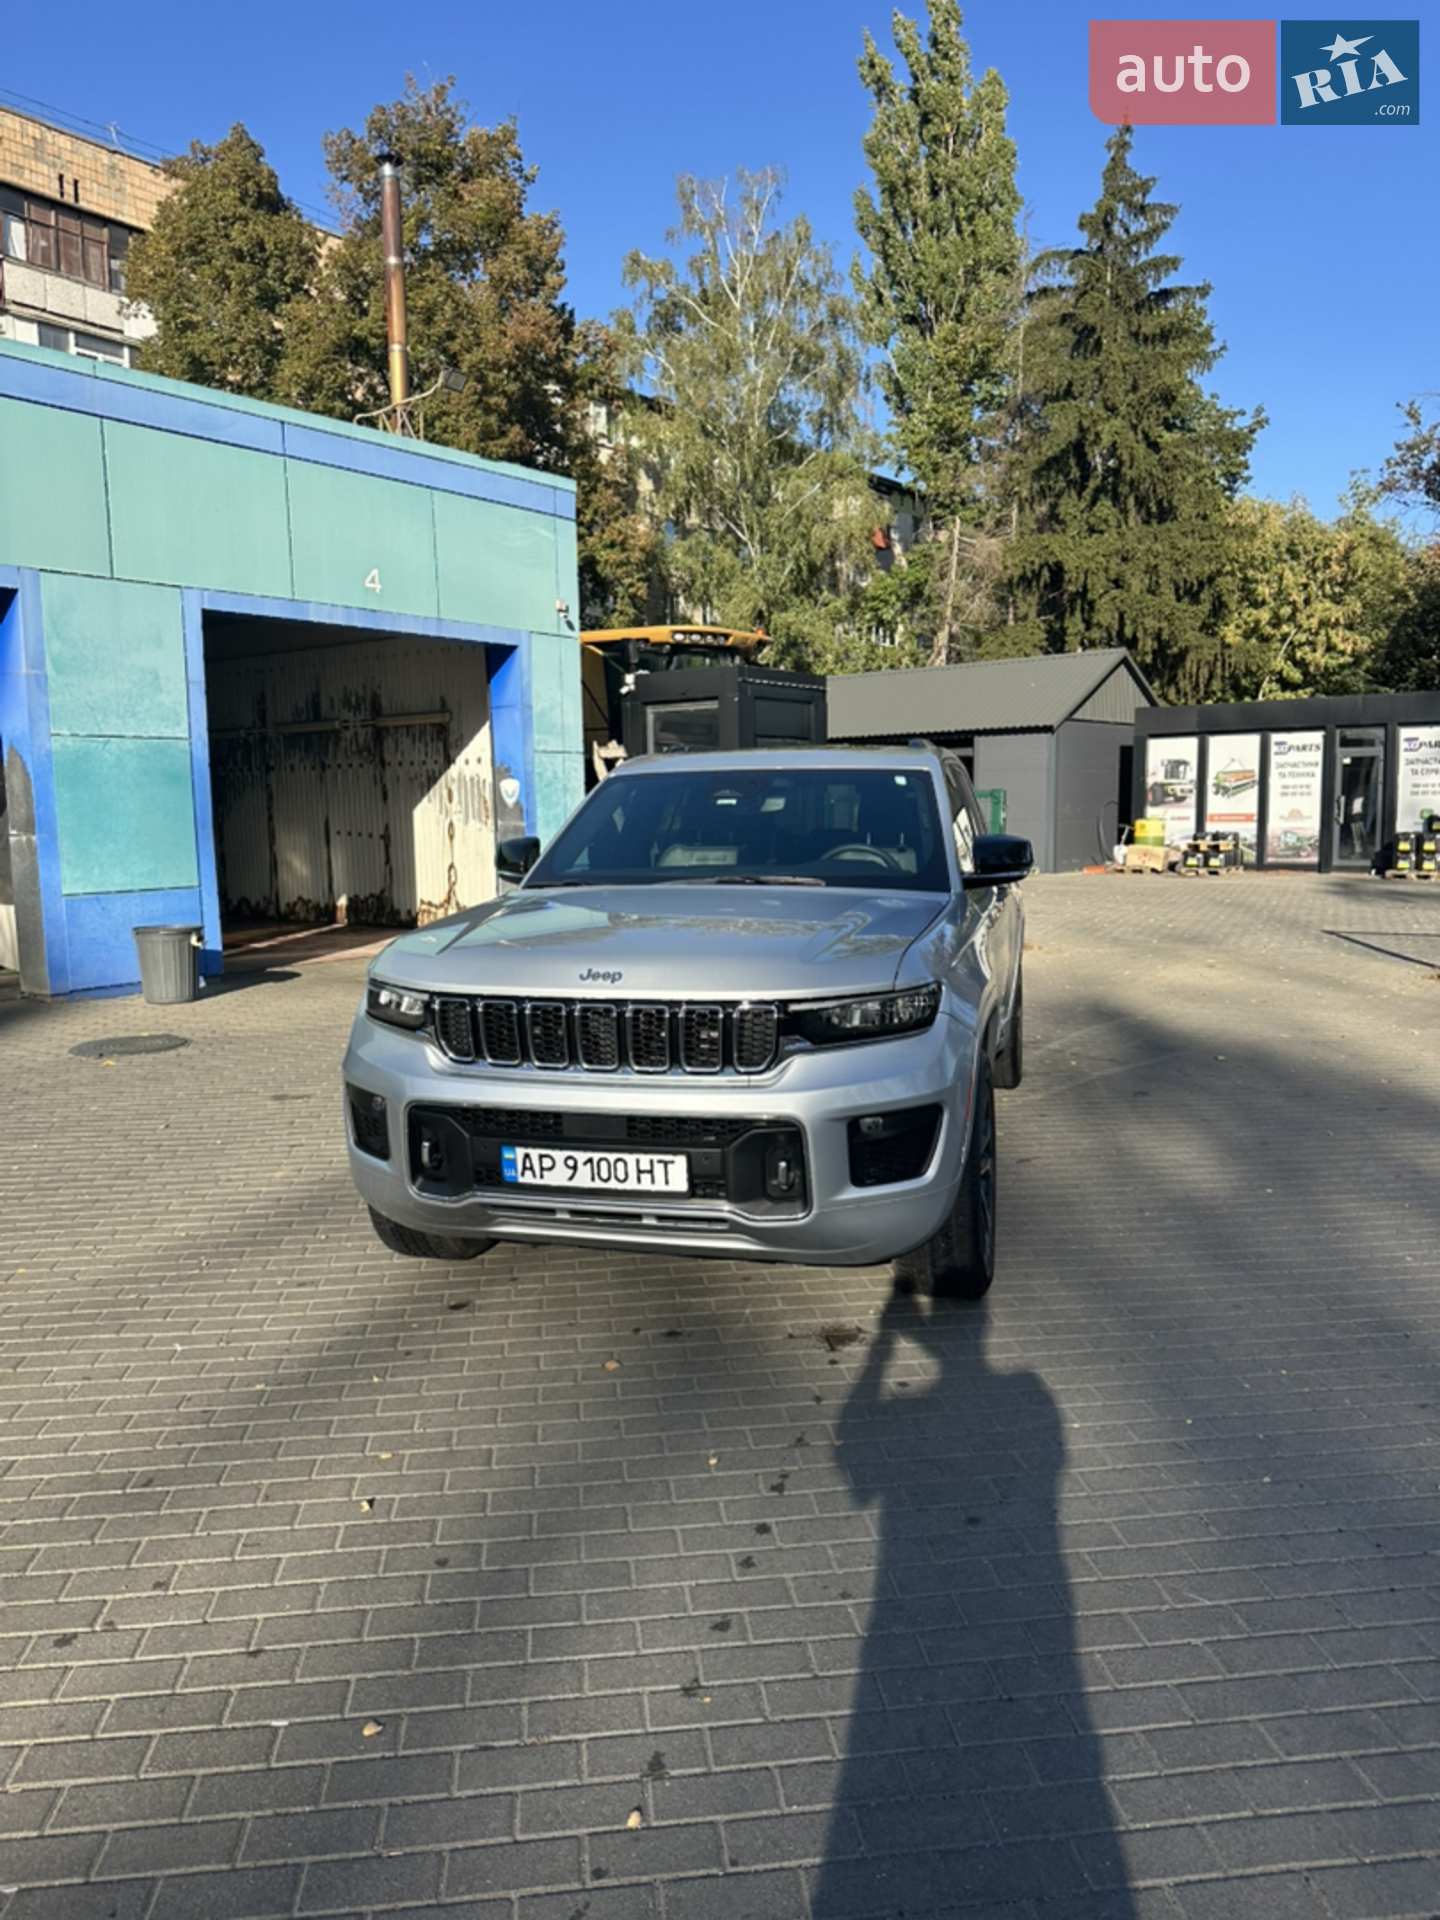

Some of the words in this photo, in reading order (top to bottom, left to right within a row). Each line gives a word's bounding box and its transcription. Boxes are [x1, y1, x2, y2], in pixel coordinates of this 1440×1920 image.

[363, 568, 383, 594] 4
[579, 967, 623, 984] Jeep
[504, 1167, 517, 1177] UA
[520, 1151, 556, 1180] AP
[563, 1155, 629, 1184] 9100
[635, 1158, 675, 1186] HT
